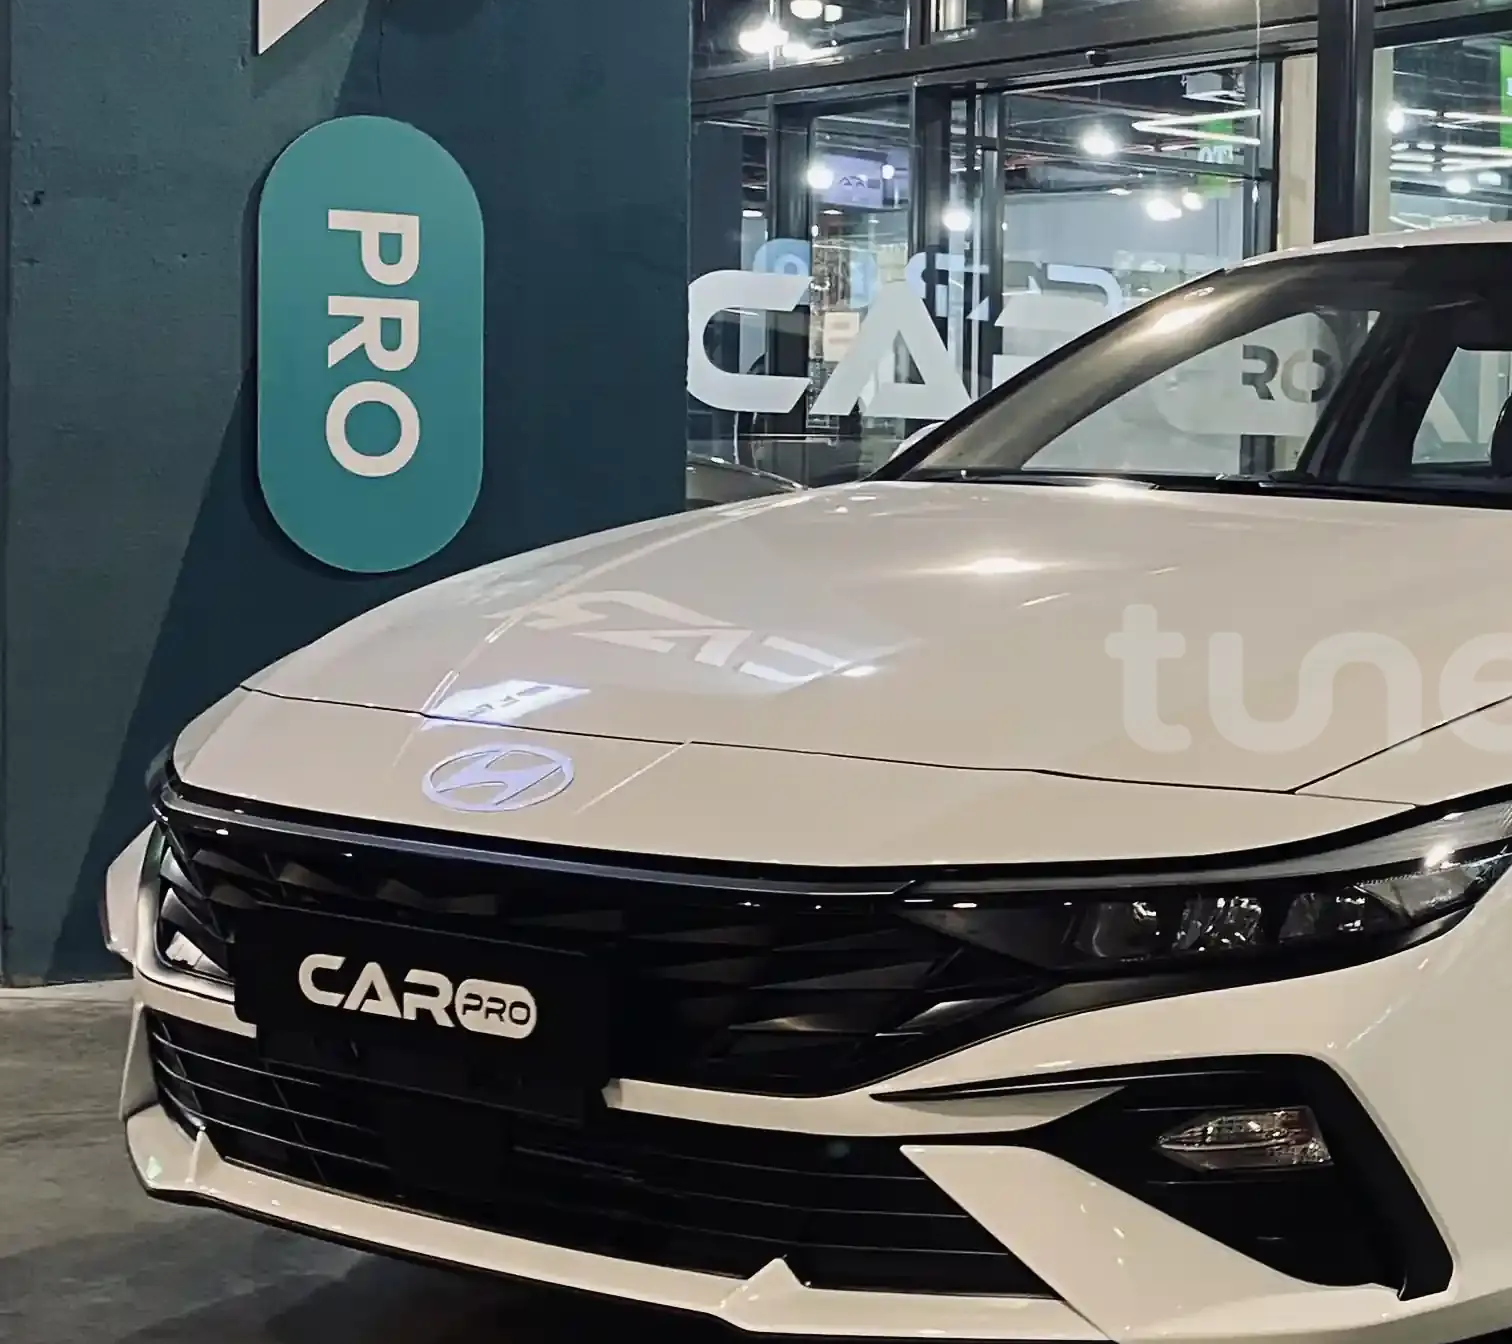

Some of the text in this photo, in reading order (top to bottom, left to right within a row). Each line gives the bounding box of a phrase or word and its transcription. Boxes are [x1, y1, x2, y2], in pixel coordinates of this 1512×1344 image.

[326, 209, 420, 477] PRO
[299, 954, 531, 1028] CAR PRO
